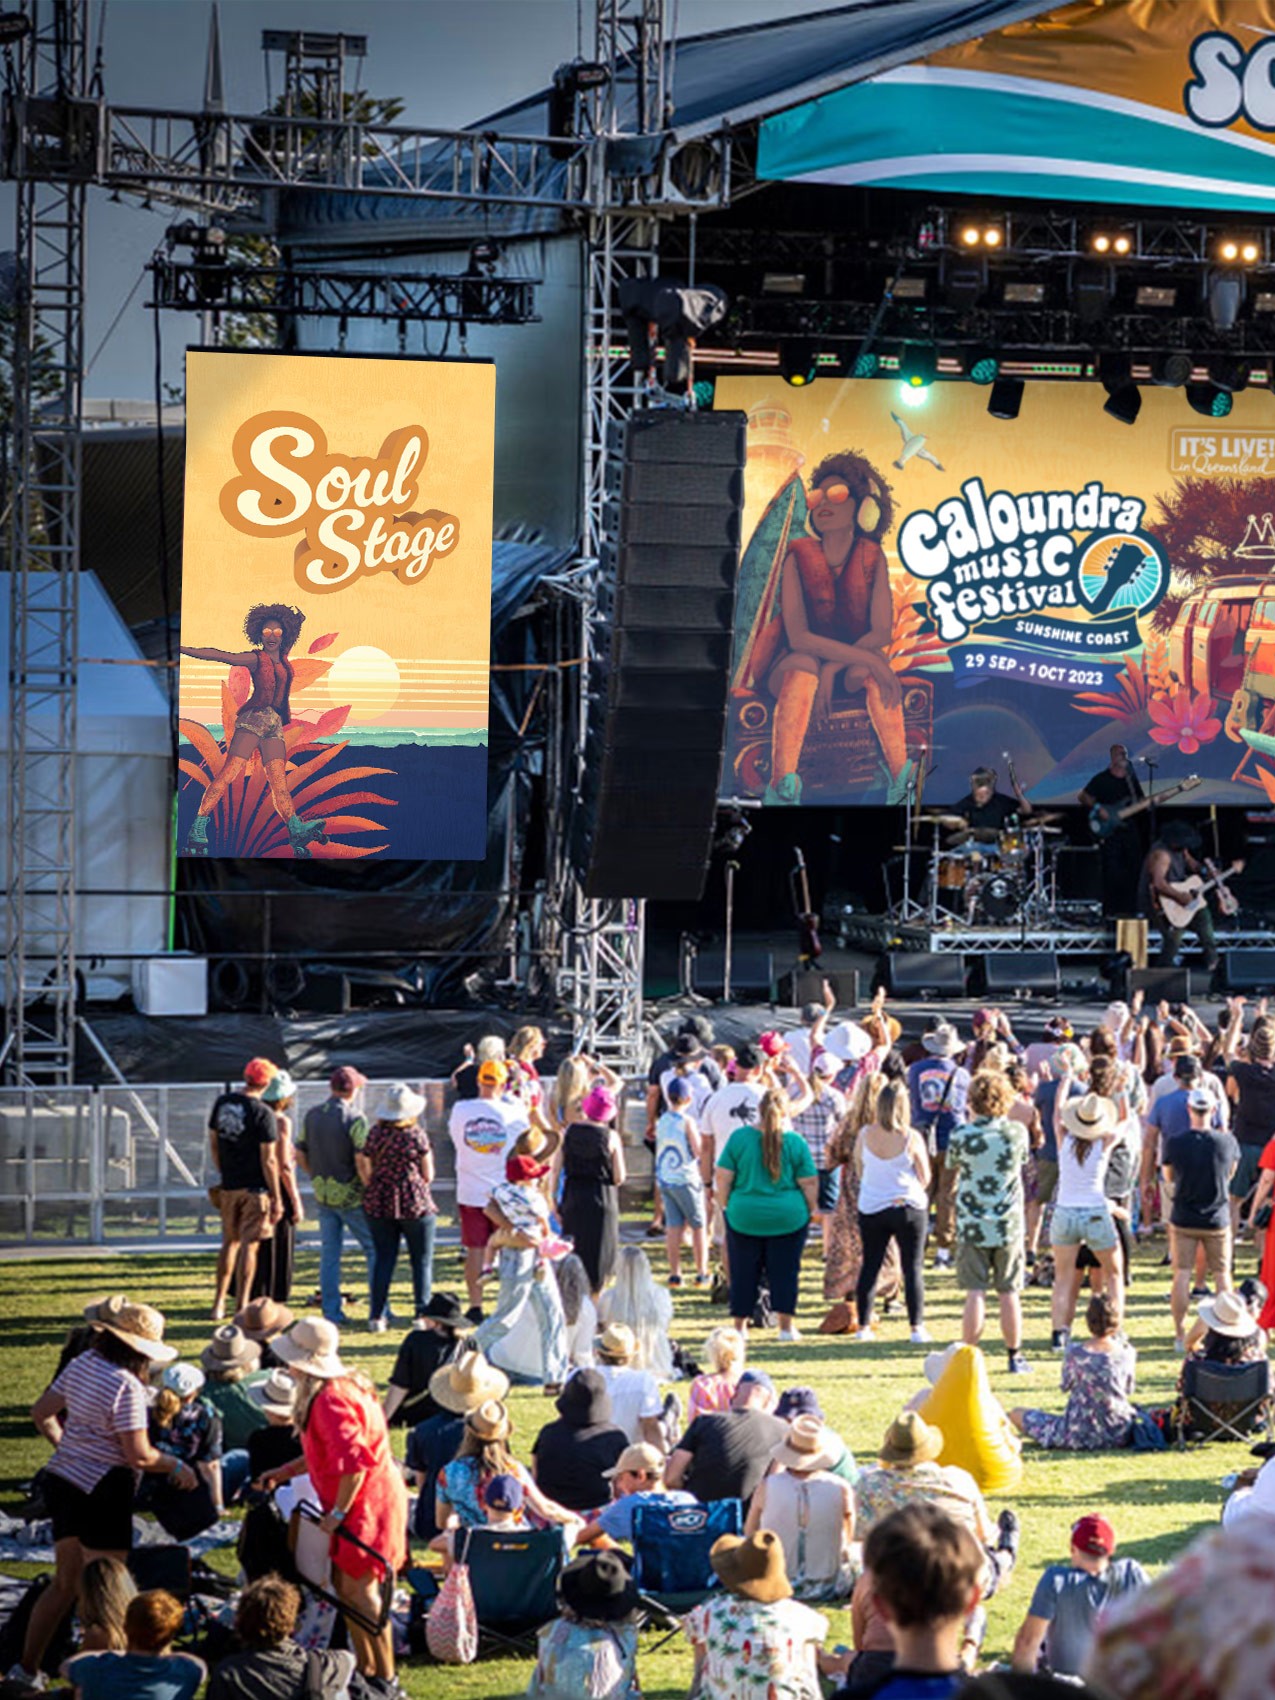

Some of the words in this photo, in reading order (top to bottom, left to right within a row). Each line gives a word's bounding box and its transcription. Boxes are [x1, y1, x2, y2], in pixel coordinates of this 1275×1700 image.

[1179, 436, 1217, 458] IT'S
[1221, 437, 1275, 458] LIVE!
[1179, 462, 1191, 472] in
[1191, 453, 1271, 476] Queensland
[236, 425, 422, 526] Soul
[305, 508, 455, 586] Stage
[899, 479, 1143, 578] Caloundra
[952, 534, 1075, 585] music
[929, 579, 1078, 641] festival
[1015, 620, 1083, 644] SUNSHINE
[1085, 630, 1130, 646] COAST
[965, 653, 986, 669] 29
[988, 655, 1018, 672] SEP
[1067, 668, 1104, 686] 2023
